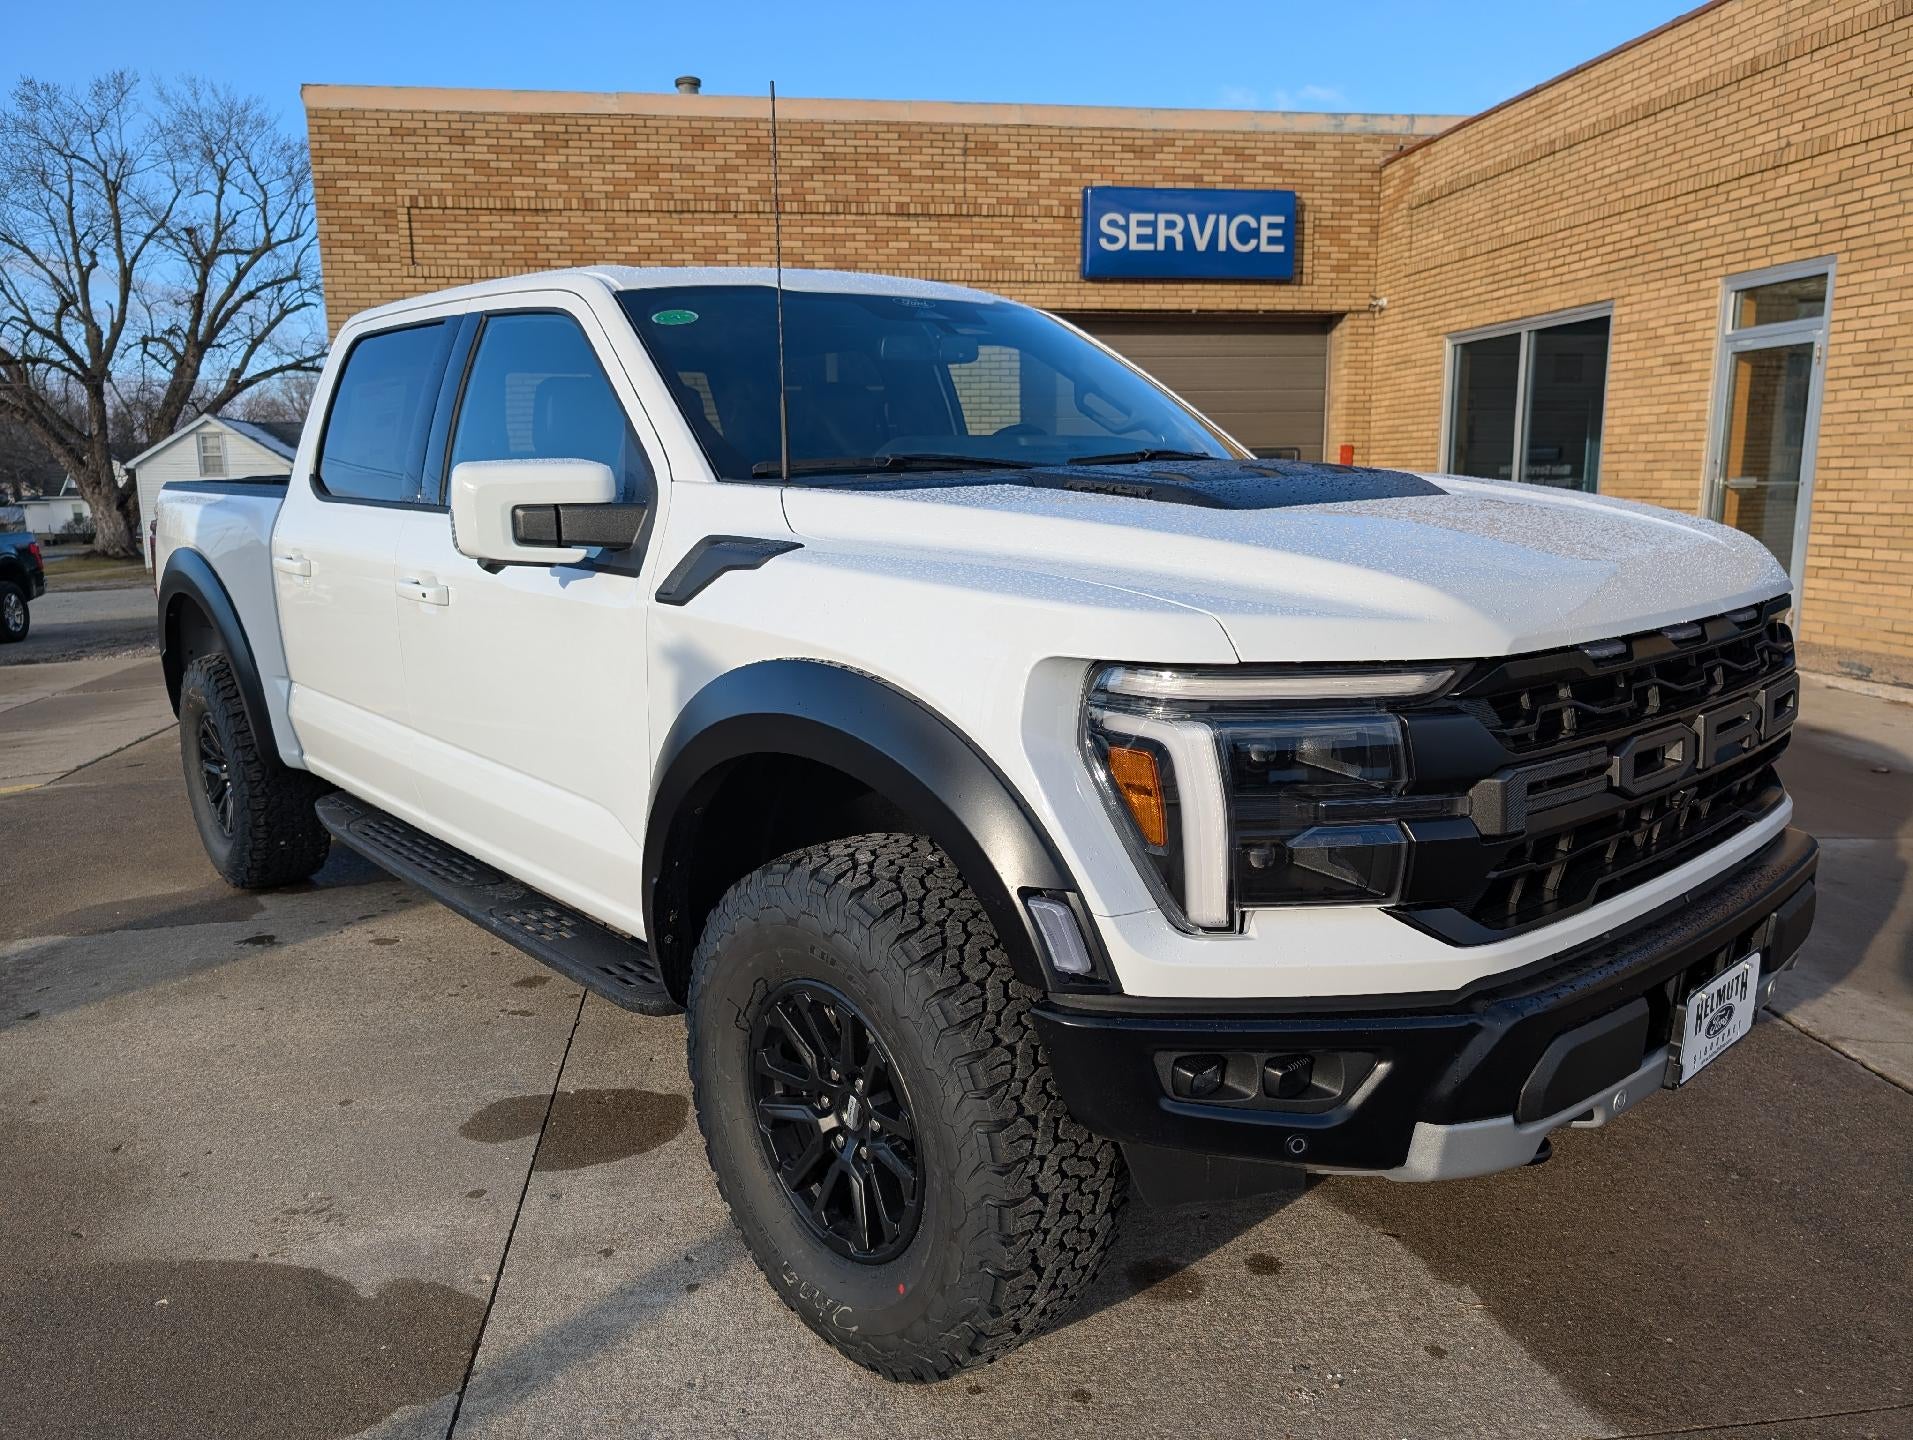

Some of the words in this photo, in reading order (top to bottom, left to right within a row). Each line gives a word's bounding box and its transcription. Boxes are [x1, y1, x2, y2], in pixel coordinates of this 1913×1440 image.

[1099, 212, 1285, 253] SERVICE
[1472, 671, 1800, 836] FORD
[1694, 967, 1749, 1037] HELMUTH
